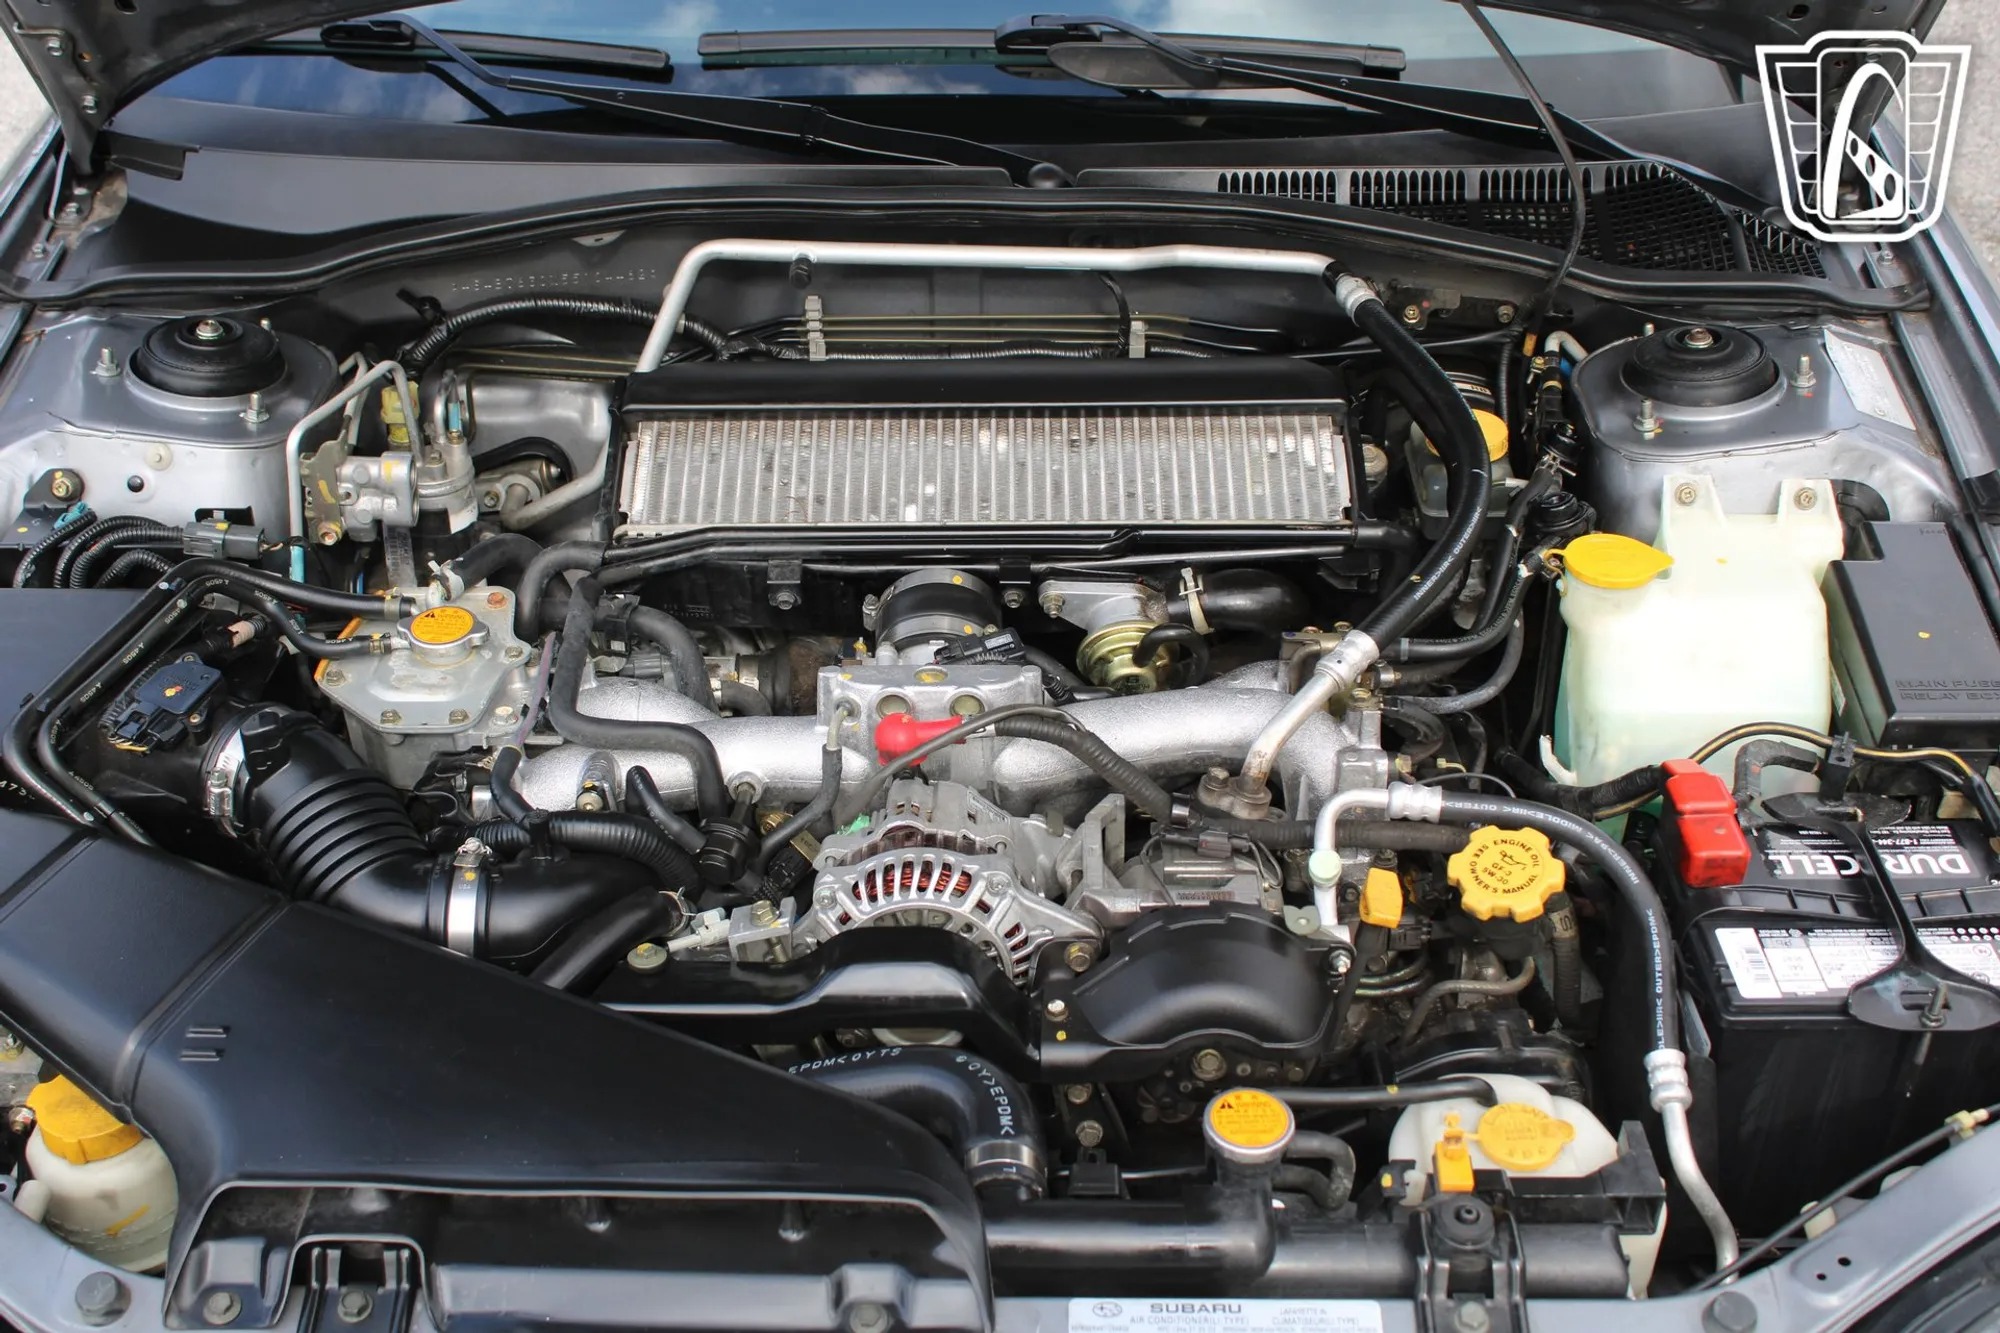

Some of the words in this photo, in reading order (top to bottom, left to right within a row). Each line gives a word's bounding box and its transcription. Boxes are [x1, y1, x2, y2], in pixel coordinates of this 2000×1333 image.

[1901, 692, 1960, 700] RELAY
[1493, 838, 1532, 852] ENGINE
[1531, 854, 1540, 868] OIL
[1476, 844, 1490, 858] SEE
[1502, 874, 1538, 894] MANUAL
[1765, 854, 1971, 876] DURCELL
[1482, 867, 1509, 884] 5W-30
[1150, 1302, 1242, 1314] SUBARU
